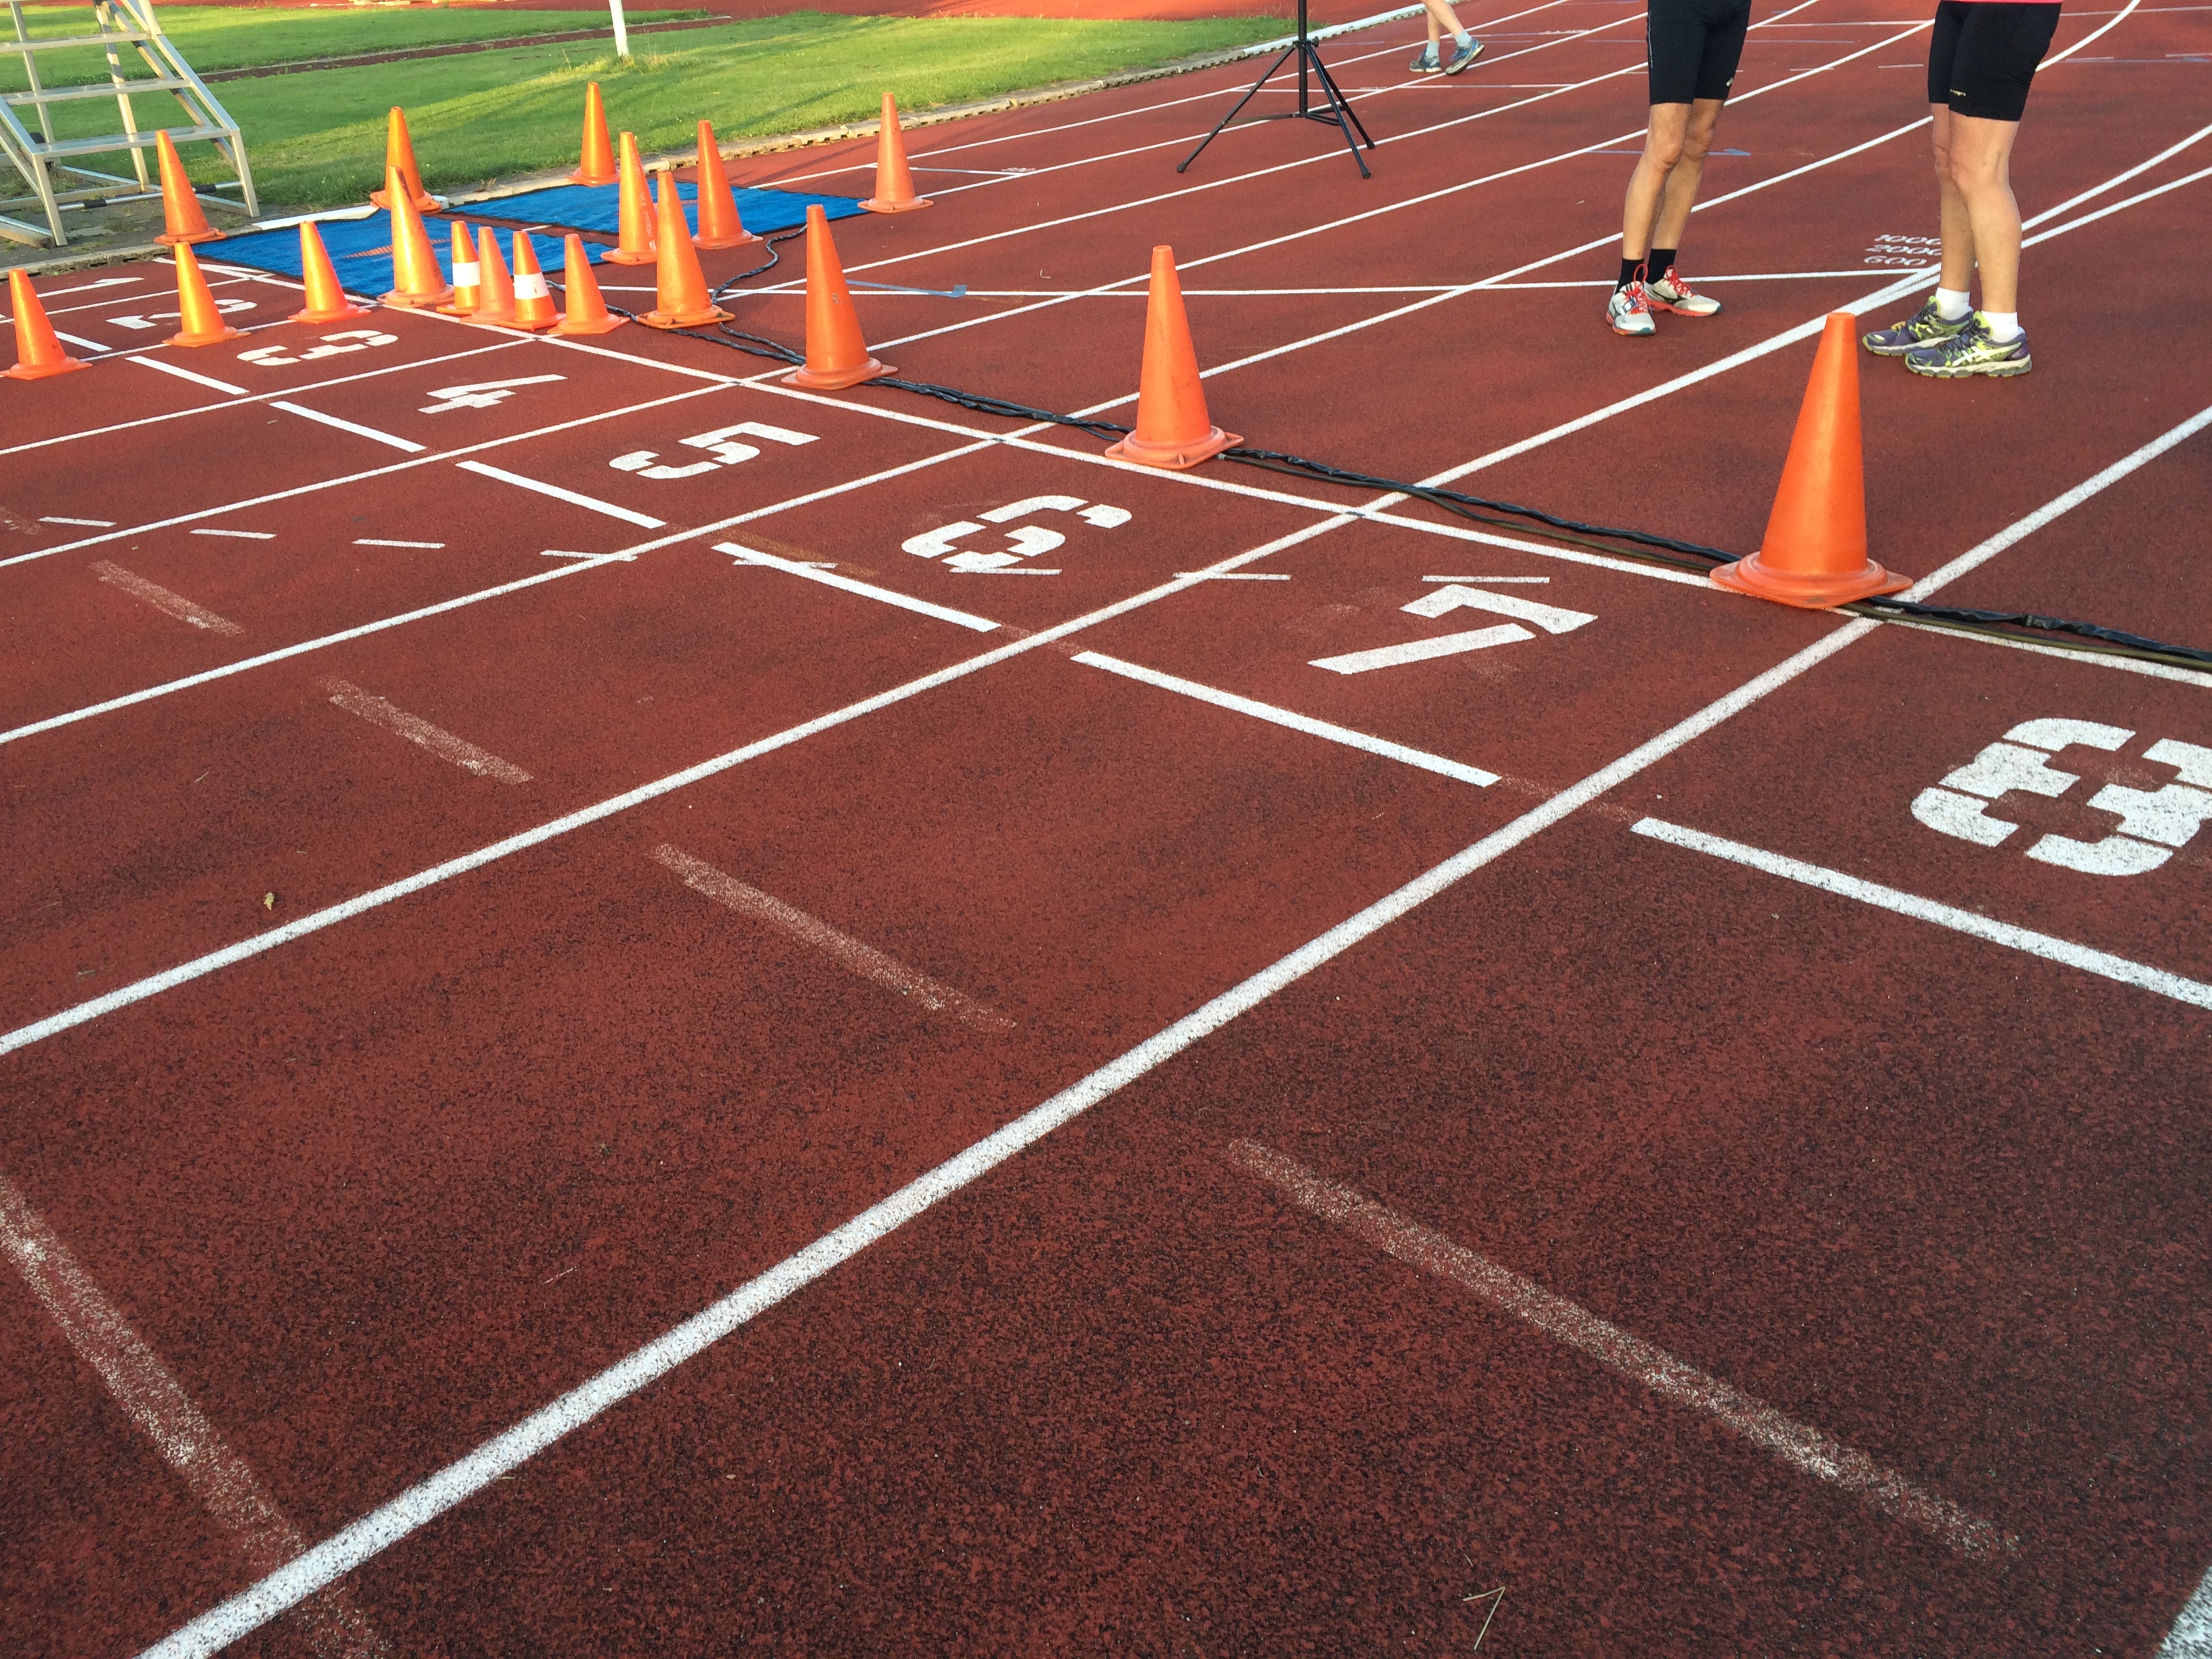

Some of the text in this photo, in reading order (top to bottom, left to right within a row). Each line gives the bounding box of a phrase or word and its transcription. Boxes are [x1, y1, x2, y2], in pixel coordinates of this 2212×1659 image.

[1864, 255, 1927, 266] 600
[237, 330, 398, 366] 3
[417, 374, 568, 414] 4
[609, 422, 821, 479] 5
[901, 495, 1132, 568] 6
[1307, 583, 1598, 675] 7
[1910, 718, 2212, 876] 8
